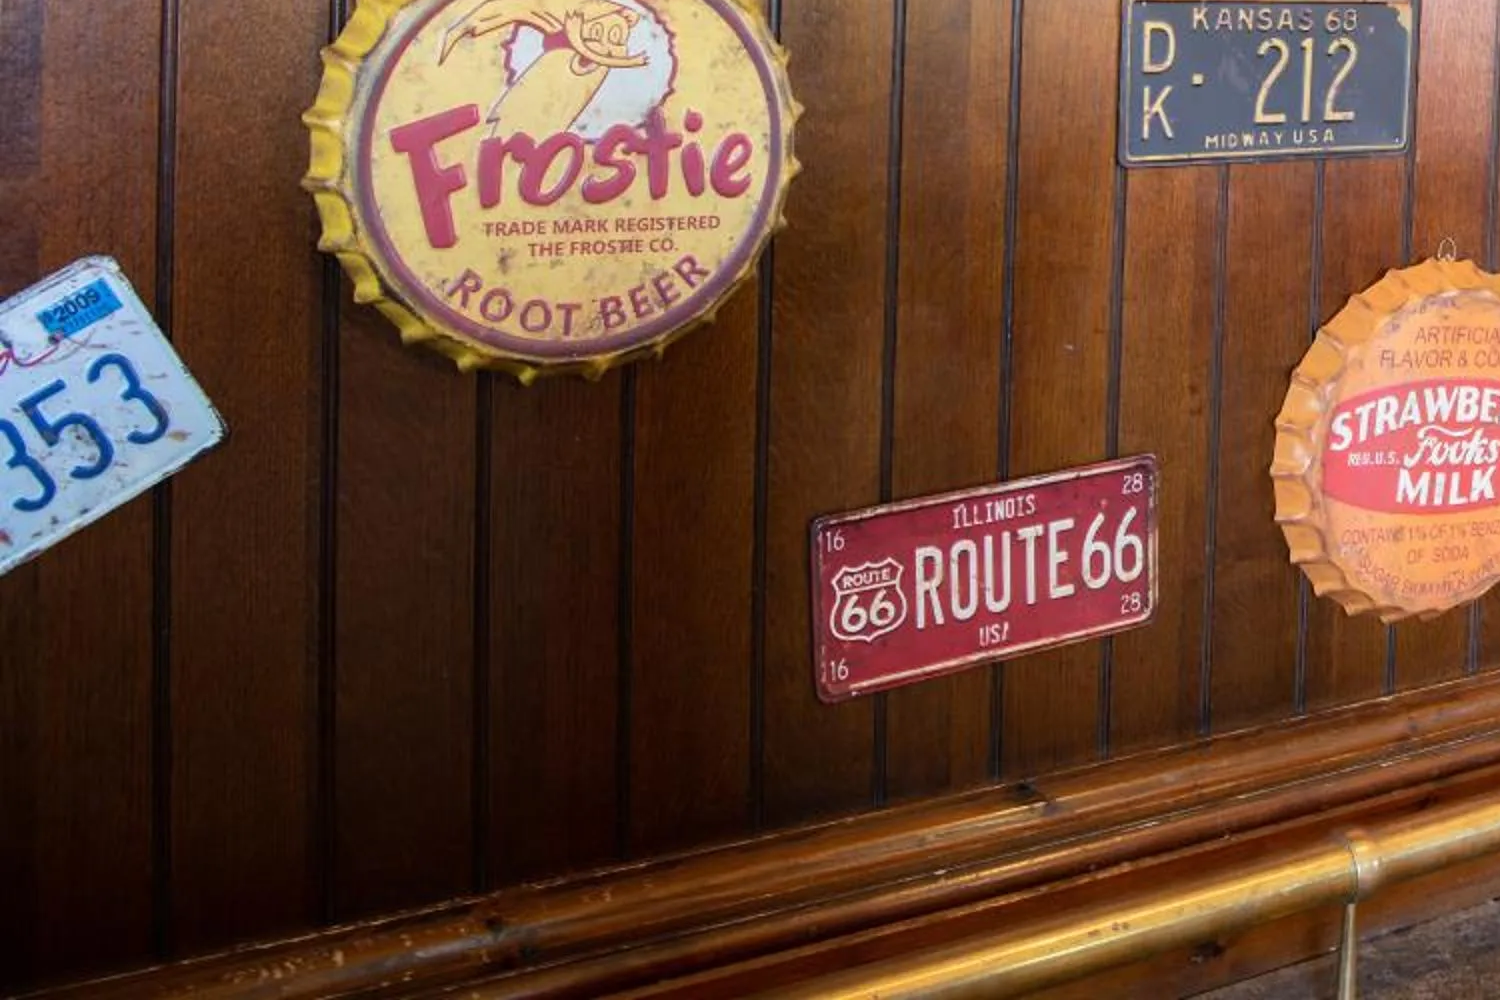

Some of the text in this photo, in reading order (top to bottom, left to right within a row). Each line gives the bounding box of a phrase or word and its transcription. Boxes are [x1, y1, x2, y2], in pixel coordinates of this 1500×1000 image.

[1192, 7, 1314, 32] KANSAS
[1254, 36, 1359, 125] 212
[1204, 127, 1336, 150] MIDWAY USA
[390, 103, 753, 249] Frostie
[484, 215, 721, 237] TRADE MARK REGISTERED
[528, 237, 680, 257] THE FROSTIE CO.
[51, 286, 100, 322] 2009
[446, 253, 712, 337] ROOT BEER
[1379, 350, 1452, 370] FLAVOR
[1458, 351, 1468, 367] &
[1122, 473, 1144, 496] 28
[1395, 465, 1498, 506] MILK
[952, 493, 1037, 530] ILLINOIS
[825, 528, 845, 552] 16
[841, 566, 893, 589] ROUTE
[915, 506, 1144, 630] ROUTE 66
[841, 590, 897, 634] 66
[1120, 591, 1142, 615] 28
[830, 657, 850, 683] 16
